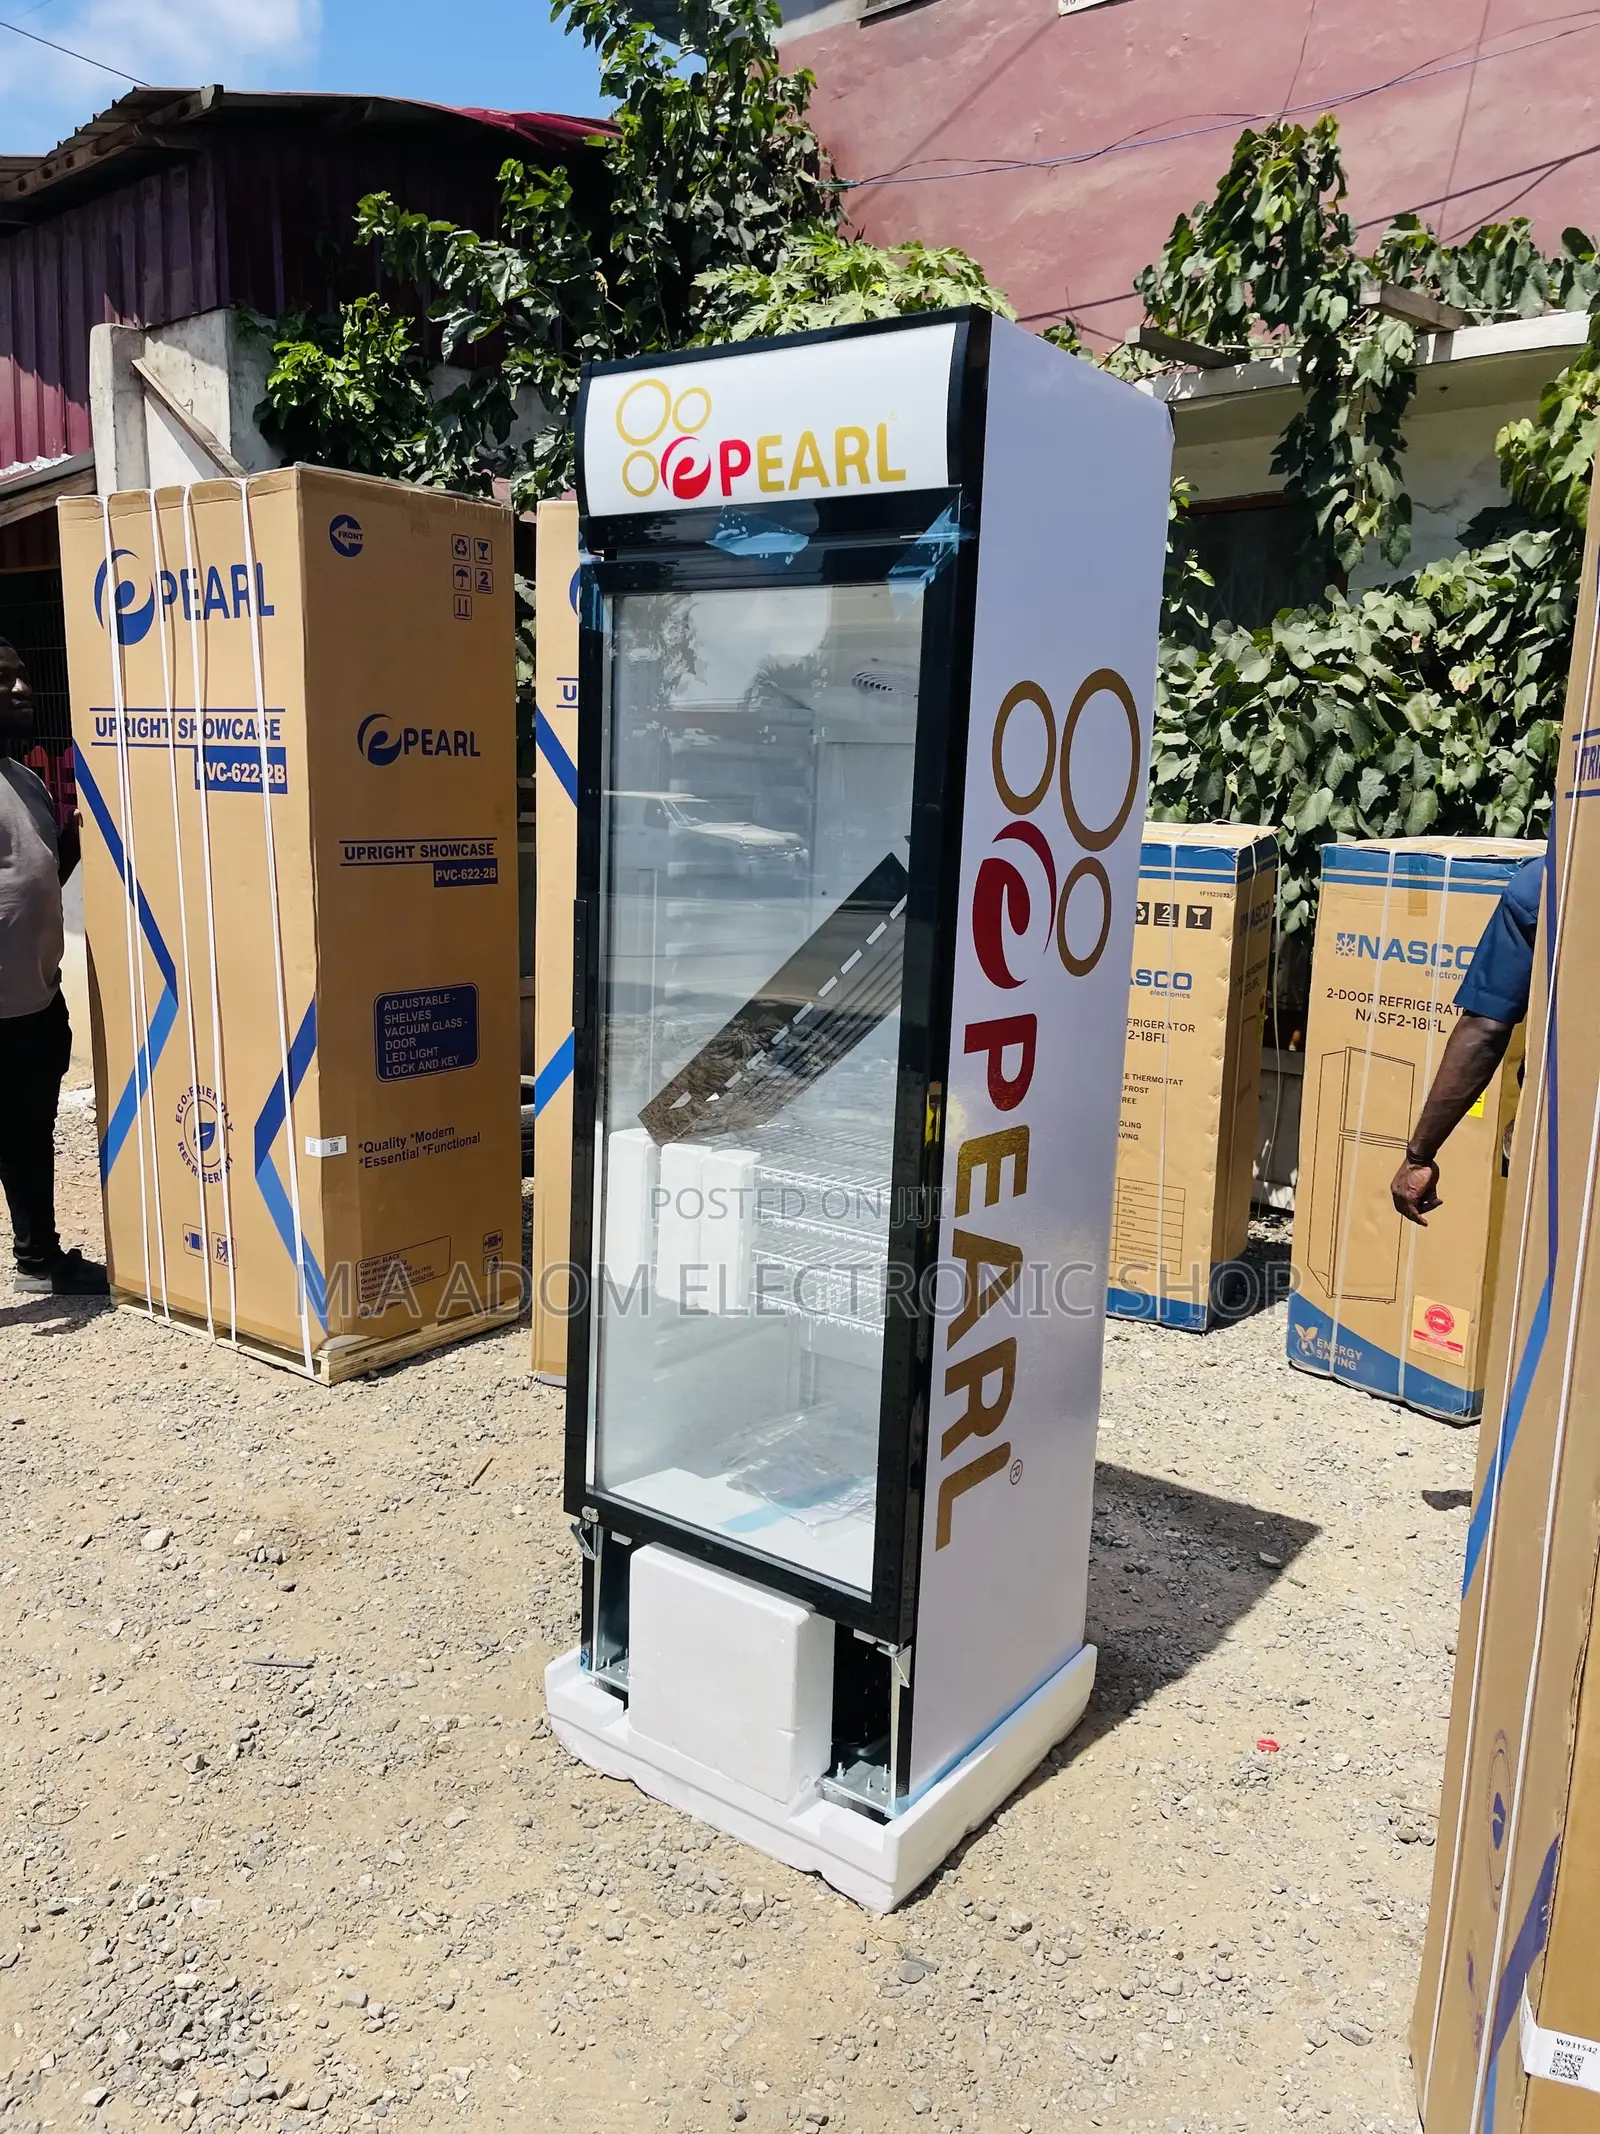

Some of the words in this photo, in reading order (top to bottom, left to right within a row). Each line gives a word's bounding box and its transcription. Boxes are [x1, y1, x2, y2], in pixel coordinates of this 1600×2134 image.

[719, 423, 907, 497] PEARL
[338, 530, 364, 541] FRONT
[154, 562, 275, 622] PEARL
[403, 728, 481, 757] PEARL
[344, 845, 415, 860] UPRIGHT
[420, 843, 495, 858] SHOWCASE
[435, 867, 497, 882] PVC-622-2B
[1130, 968, 1192, 991] SCO
[384, 994, 450, 1011] ADJUSTABLE
[1379, 995, 1465, 1017] REFRIGERAT
[384, 1010, 432, 1025] SHELVES
[385, 1023, 429, 1038] VACUUM
[432, 1018, 462, 1031] GLASS
[385, 1037, 417, 1051] DOOR
[385, 1051, 406, 1064] LED
[409, 1046, 439, 1060] LIGHT
[386, 1063, 416, 1076] LOCK
[418, 1059, 439, 1072] AND
[441, 1055, 460, 1067] KEY
[935, 1013, 1038, 1552] PEARL
[1316, 1349, 1357, 1371] SAING
